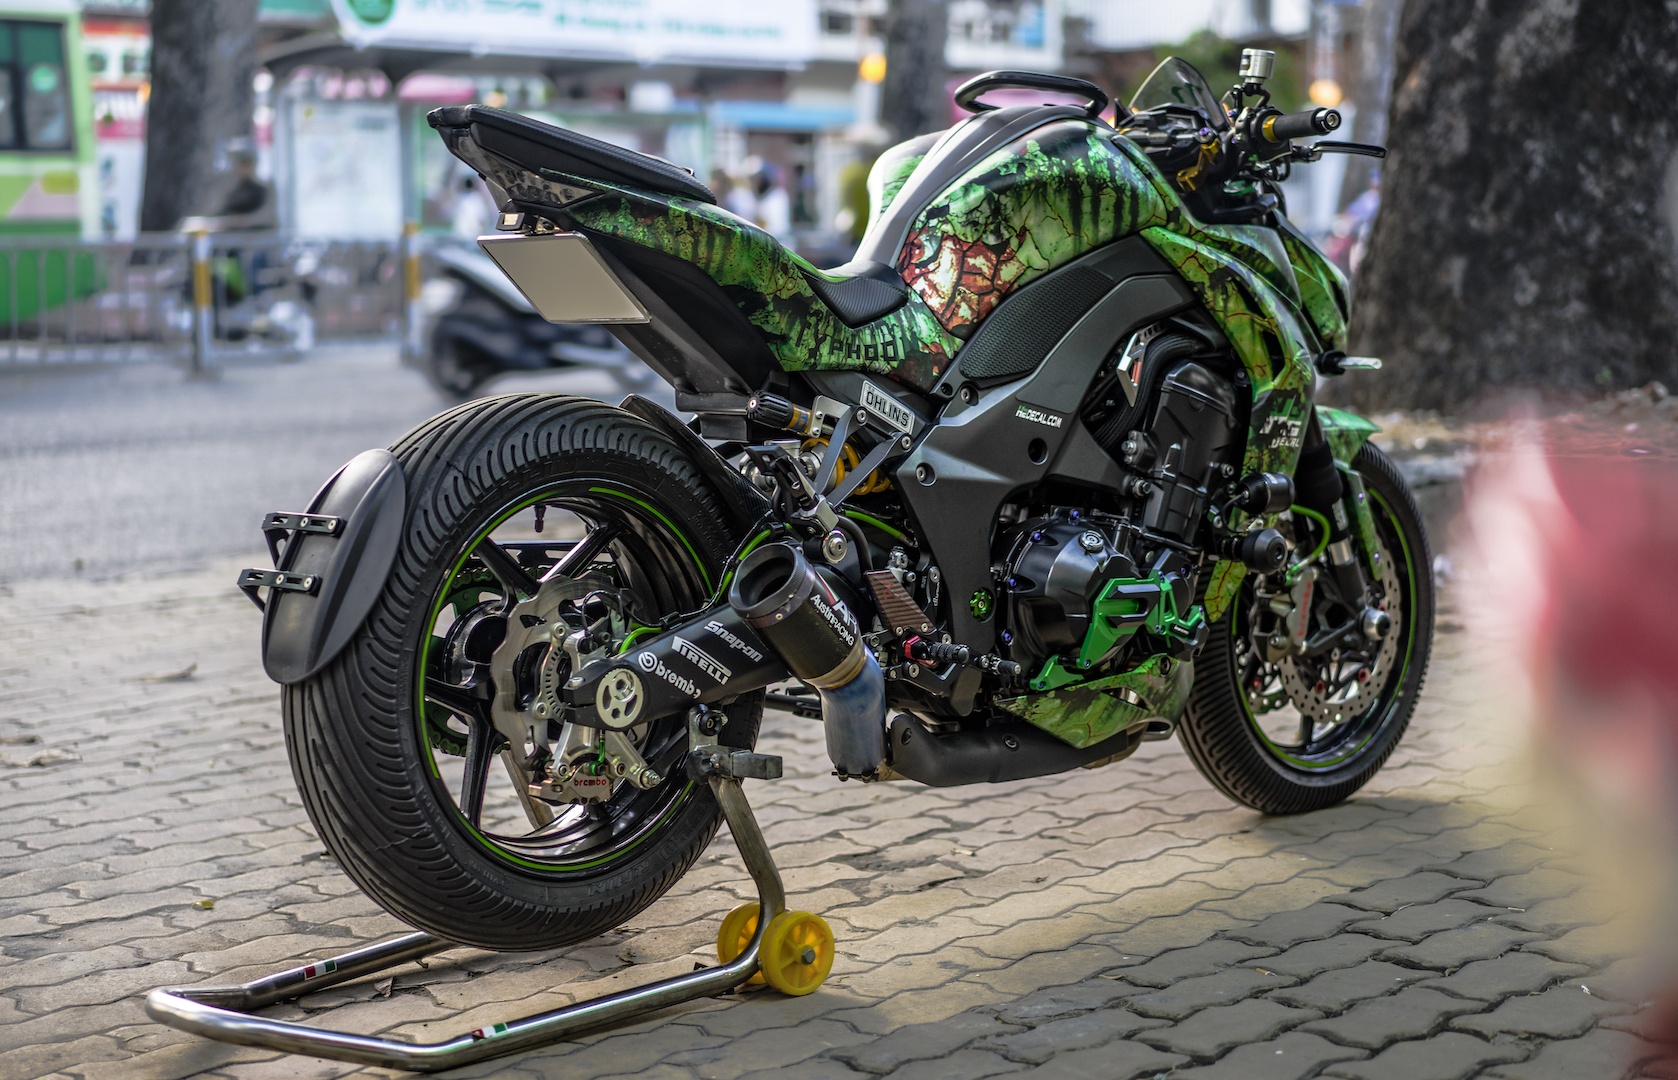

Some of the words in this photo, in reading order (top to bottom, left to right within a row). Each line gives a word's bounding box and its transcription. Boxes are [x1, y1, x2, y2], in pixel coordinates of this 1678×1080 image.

[832, 600, 857, 634] AR
[704, 620, 764, 663] Snap-on
[671, 635, 733, 687] PIRELLI
[574, 777, 606, 787] brembo
